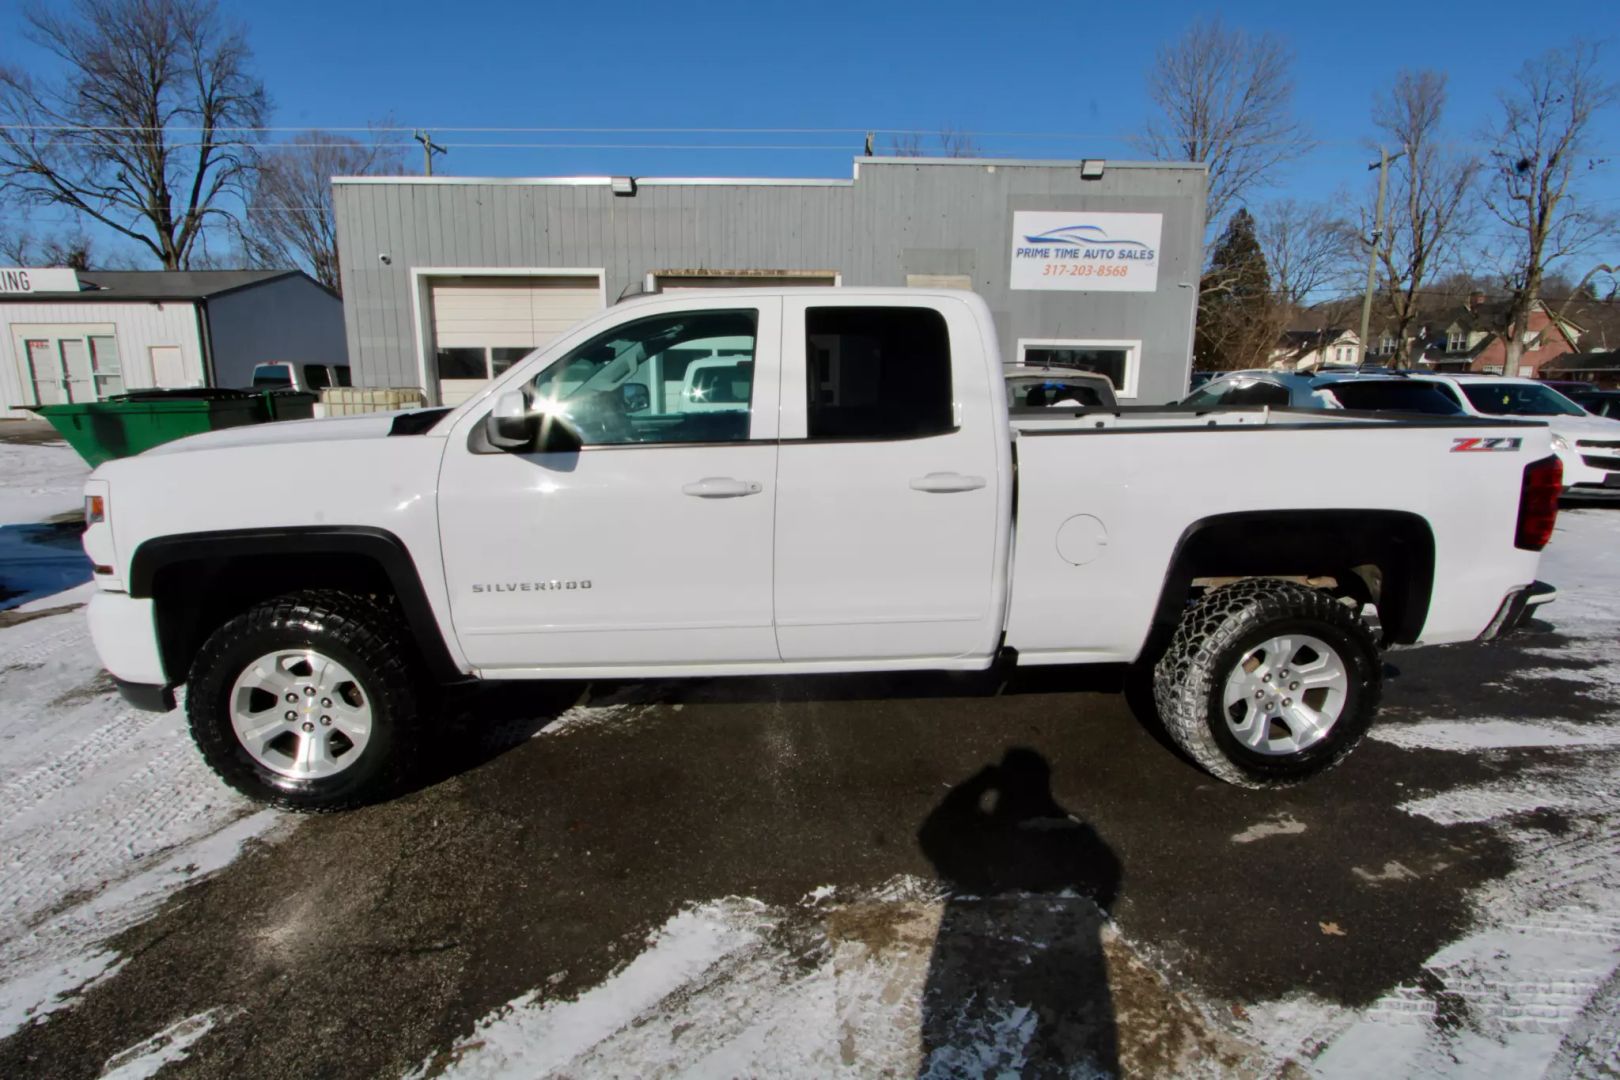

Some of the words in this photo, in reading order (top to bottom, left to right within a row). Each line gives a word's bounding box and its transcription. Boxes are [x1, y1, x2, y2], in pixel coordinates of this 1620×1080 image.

[1016, 247, 1050, 258] PRIME
[1055, 248, 1079, 259] TIME
[1083, 249, 1114, 260] AUTO
[1117, 250, 1155, 260] SALES
[1042, 263, 1128, 278] 317-203-8568
[0, 270, 31, 292] ING
[1449, 437, 1523, 453] Z71
